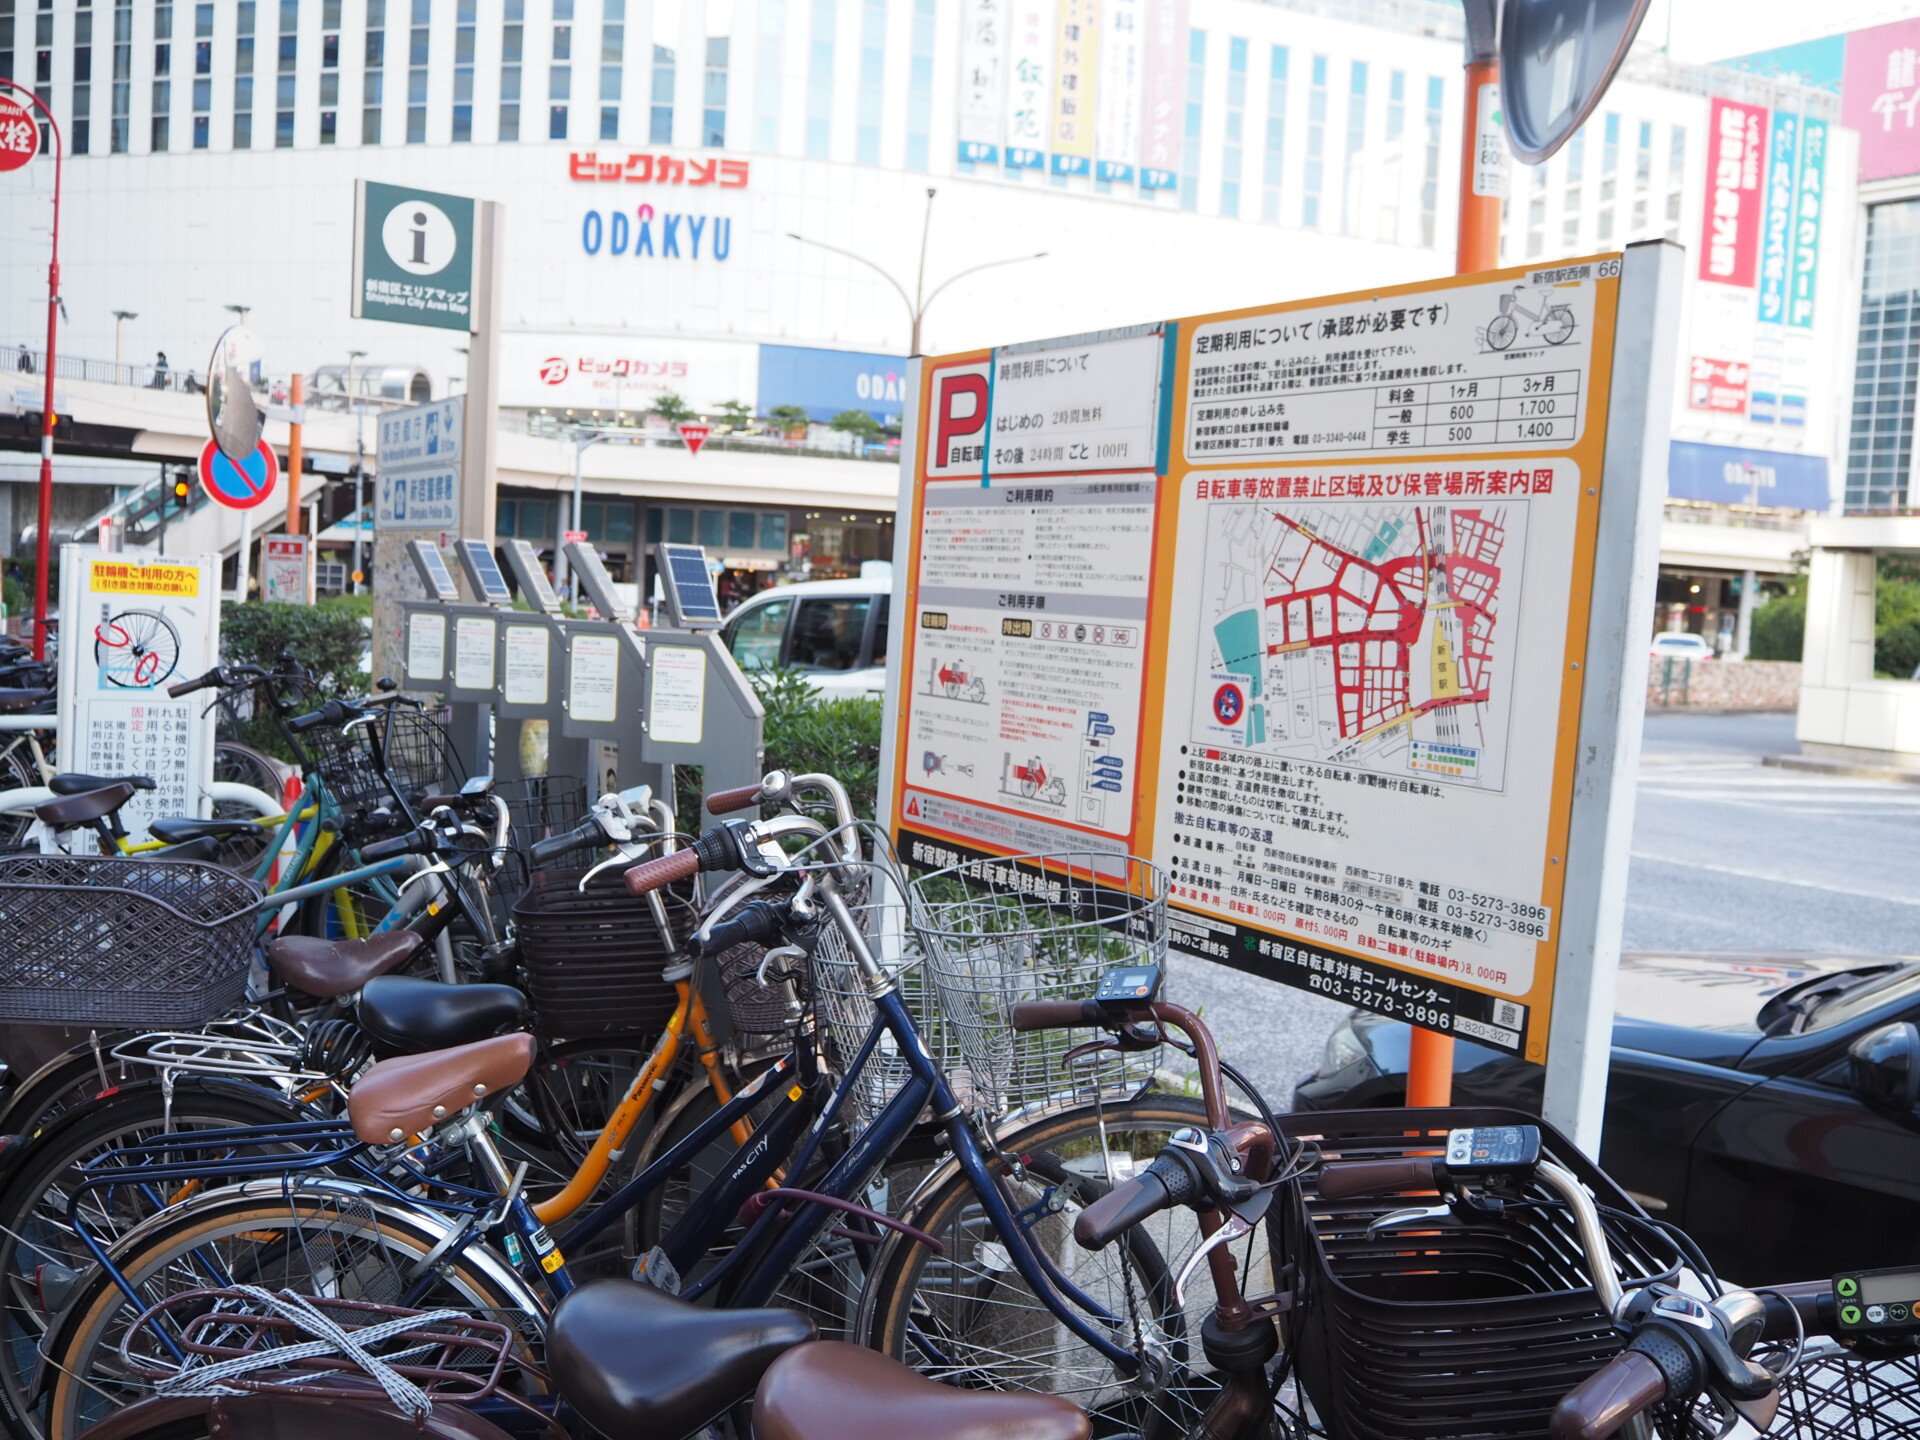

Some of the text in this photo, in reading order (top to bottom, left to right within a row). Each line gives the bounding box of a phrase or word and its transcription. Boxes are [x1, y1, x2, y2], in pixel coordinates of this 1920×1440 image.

[569, 152, 749, 189] ビックカメラ
[1708, 106, 1746, 277] ビックカメラ
[582, 204, 731, 261] ODAKYU
[1533, 260, 1620, 285] 新宿駅西側 66
[365, 279, 470, 304] 新宿区エリアマップ
[365, 292, 469, 315] Shinjuku City Area Map
[1196, 303, 1450, 355] 定期利用について(承認が必要です)
[578, 357, 688, 377] ビックカメラ
[1000, 353, 1090, 382] 時間利用について
[1388, 388, 1416, 405] 料金
[935, 373, 990, 469] P
[996, 406, 1103, 433] はじめの 2時間無料
[1196, 403, 1286, 422] 定期利用の申し込み先
[1387, 410, 1414, 425] 一般
[1449, 405, 1475, 420] 600
[1292, 434, 1310, 446] 電話
[1312, 431, 1367, 445] 03-3340-0448
[1386, 430, 1411, 446] 学生
[1447, 426, 1473, 442] 500
[950, 445, 985, 464] 自転車
[993, 443, 1128, 465] その後 24時間 ごと 100円
[1005, 488, 1055, 504] ご利用規約
[1195, 469, 1554, 500] 自転車等放置禁止区域及び保管場所案内図
[93, 564, 197, 582] 駐輪機ご利用の方へ
[998, 594, 1047, 610] ご利用手順
[1437, 644, 1448, 690] 新宿駅
[1189, 747, 1207, 759] 上記
[1187, 772, 1325, 807] 返還の際は、返還費用を徴収します。
[1189, 759, 1320, 792] 新宿区条例に基づき即撤去します。
[1185, 796, 1350, 840] 移動の際の損傷については、補償しません。
[1186, 784, 1350, 825] 鍵等で施錠したものは切断して撤去します。
[1173, 811, 1274, 846] 撤去自転車等の返還
[1235, 841, 1257, 854] 自転車
[1263, 847, 1338, 873] 西新宿自転車保管場所
[1418, 881, 1441, 898] 電話
[1447, 888, 1547, 922] 03-5273-3896
[1236, 870, 1298, 895] 月曜日～日曜日
[1303, 886, 1489, 944] 午前8時30分～午後6時(年末年始除く)
[1262, 862, 1337, 888] 内藤町自転車保管場所
[1417, 897, 1439, 914] 電話
[1445, 904, 1545, 939] 03-5273-3896
[1377, 921, 1454, 952] 自転車等のカギ
[1258, 938, 1451, 1006] 新宿区自転車対策コールセンター
[1321, 976, 1451, 1030] 03-5273-3896
[631, 1062, 658, 1102] Panasonic
[731, 1134, 769, 1180] PAS CITY
